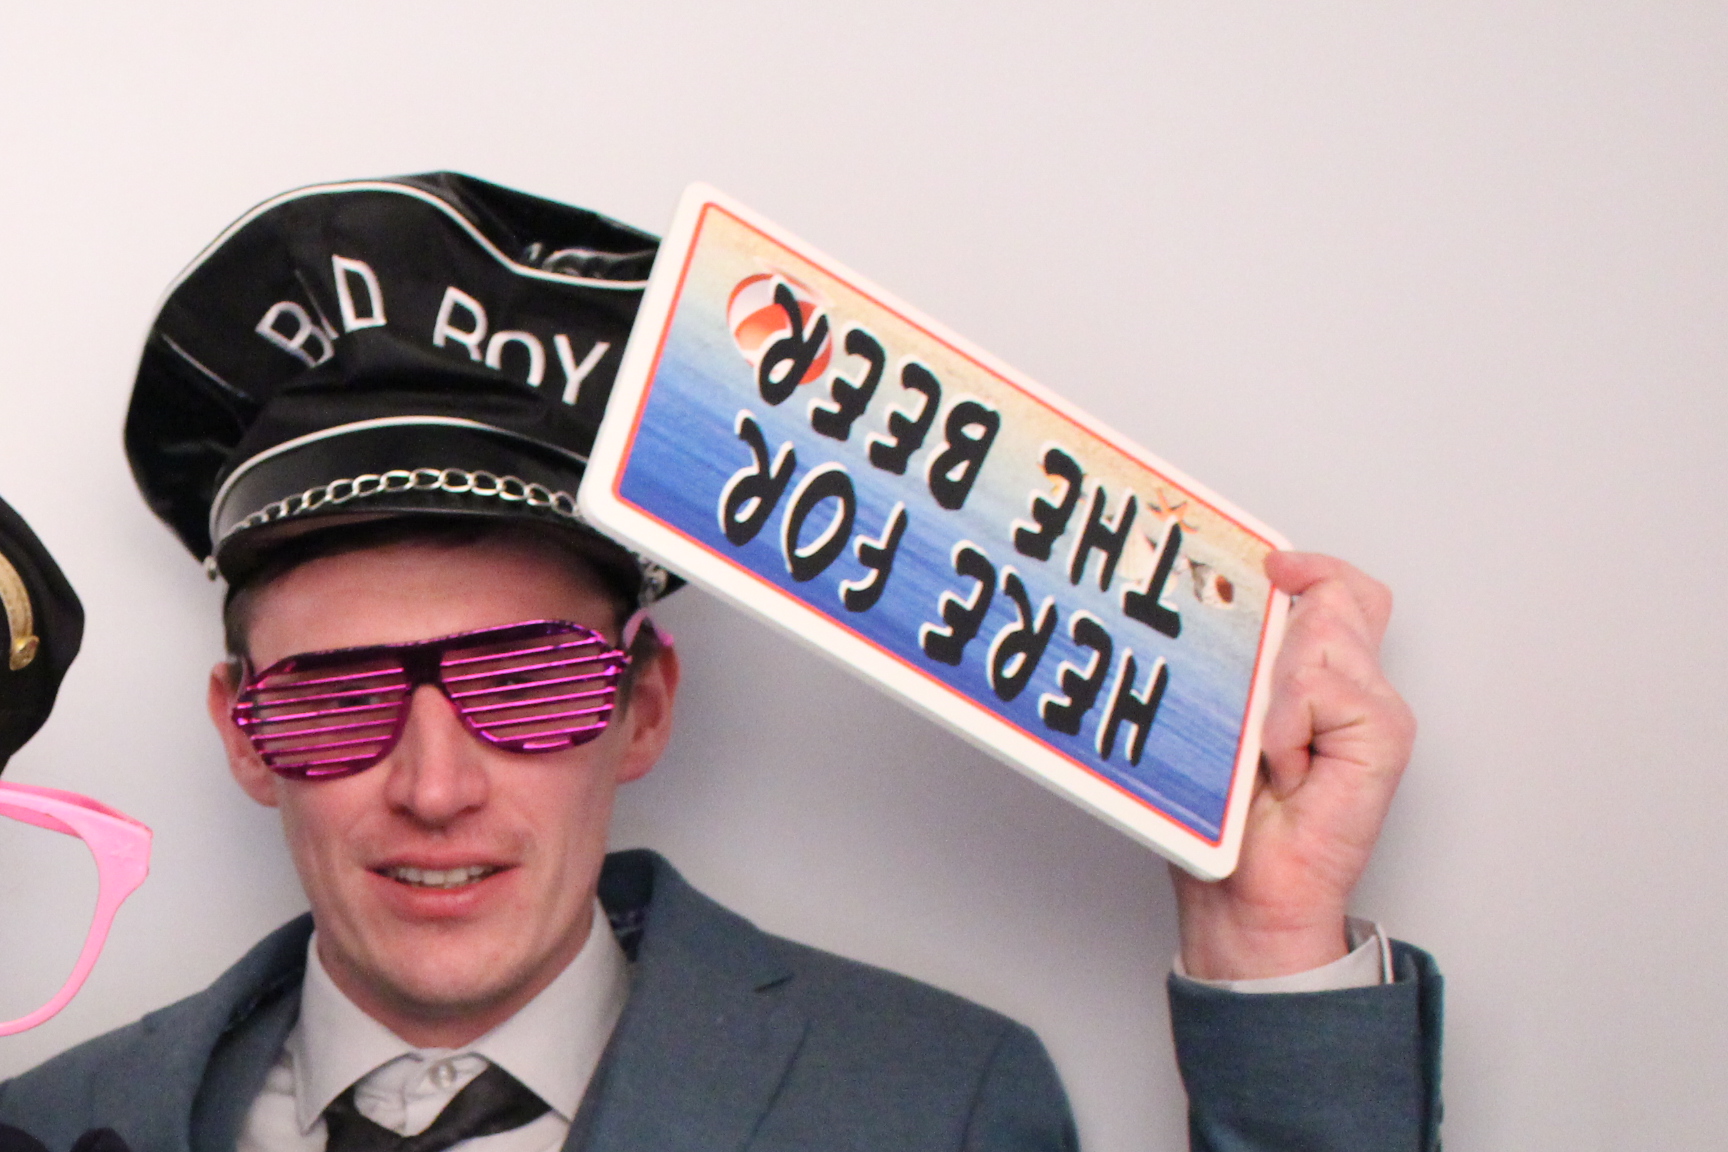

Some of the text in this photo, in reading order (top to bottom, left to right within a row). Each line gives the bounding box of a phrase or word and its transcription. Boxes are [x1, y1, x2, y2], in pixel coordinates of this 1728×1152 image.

[254, 254, 387, 369] BD
[757, 280, 1182, 639] THE BEER
[722, 415, 1168, 767] HERE FOR
